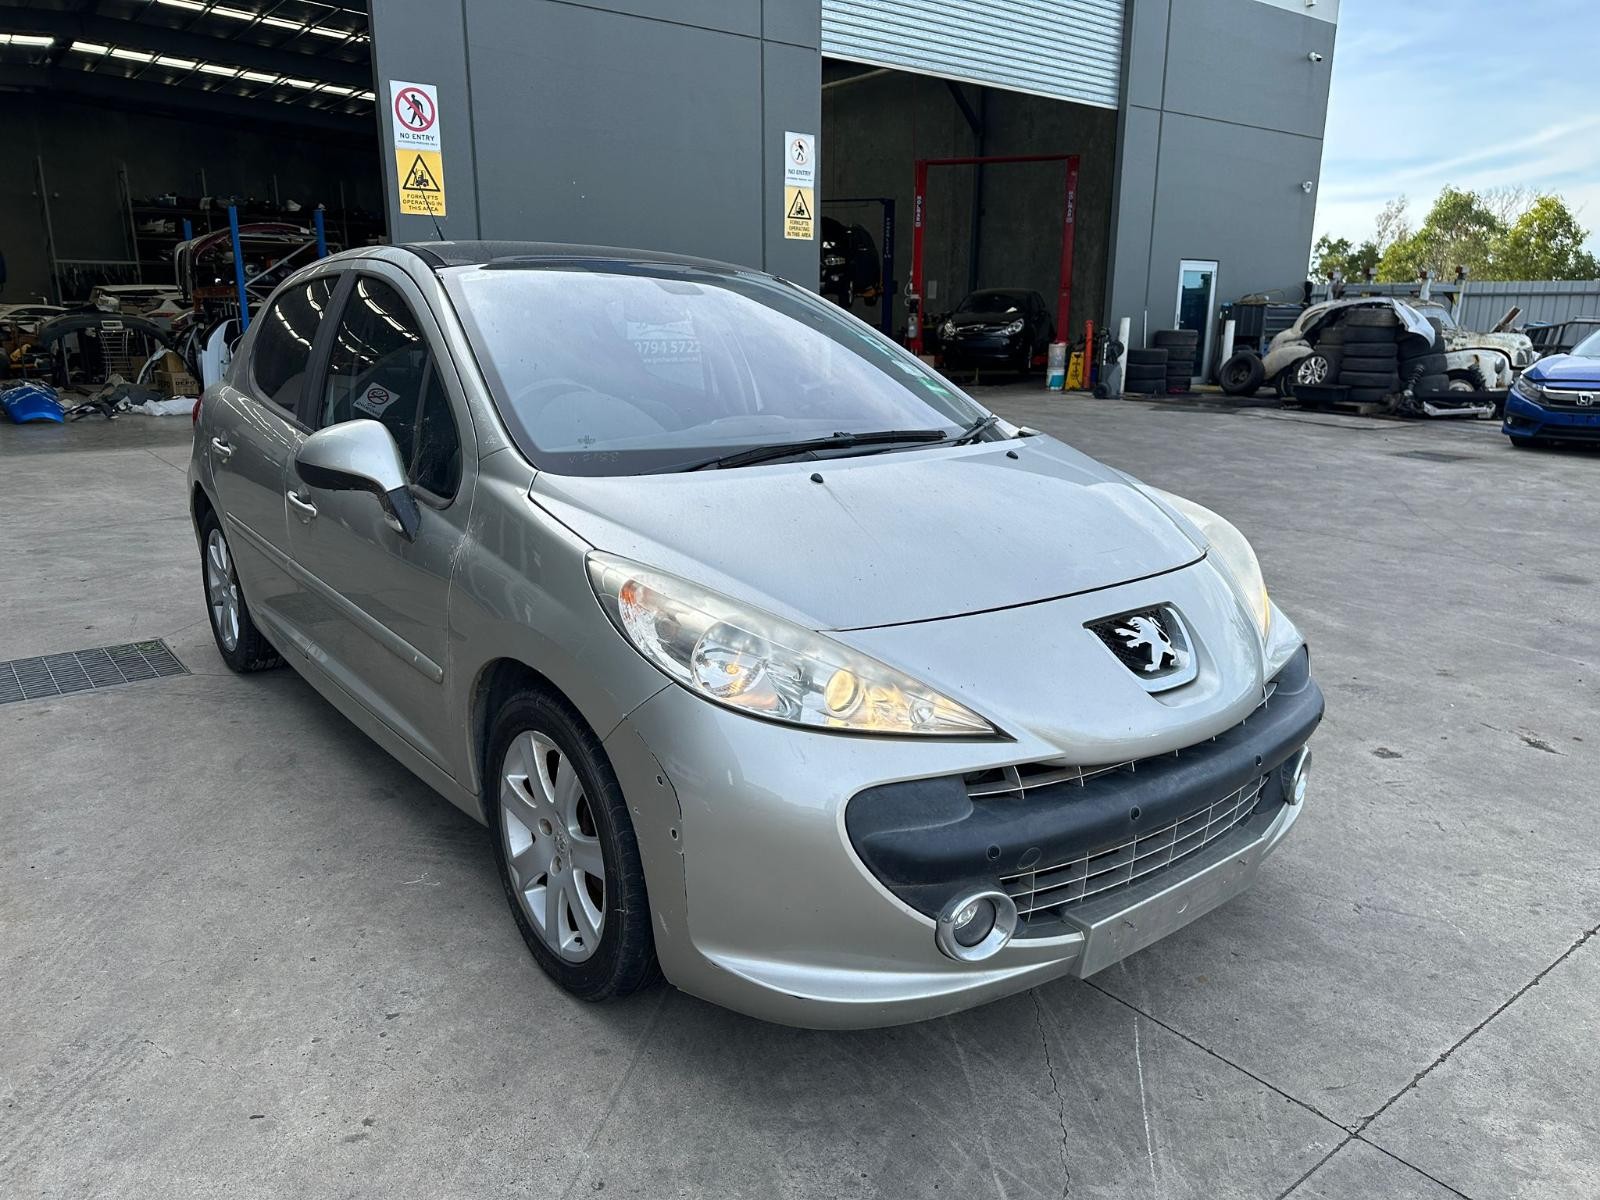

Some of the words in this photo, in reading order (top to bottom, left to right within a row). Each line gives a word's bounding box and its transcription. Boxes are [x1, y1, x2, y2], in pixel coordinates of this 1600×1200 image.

[399, 132, 410, 140] NO
[412, 133, 435, 142] ENTRY
[406, 193, 439, 201] FORKIFTS
[402, 198, 436, 206] OPERATNG
